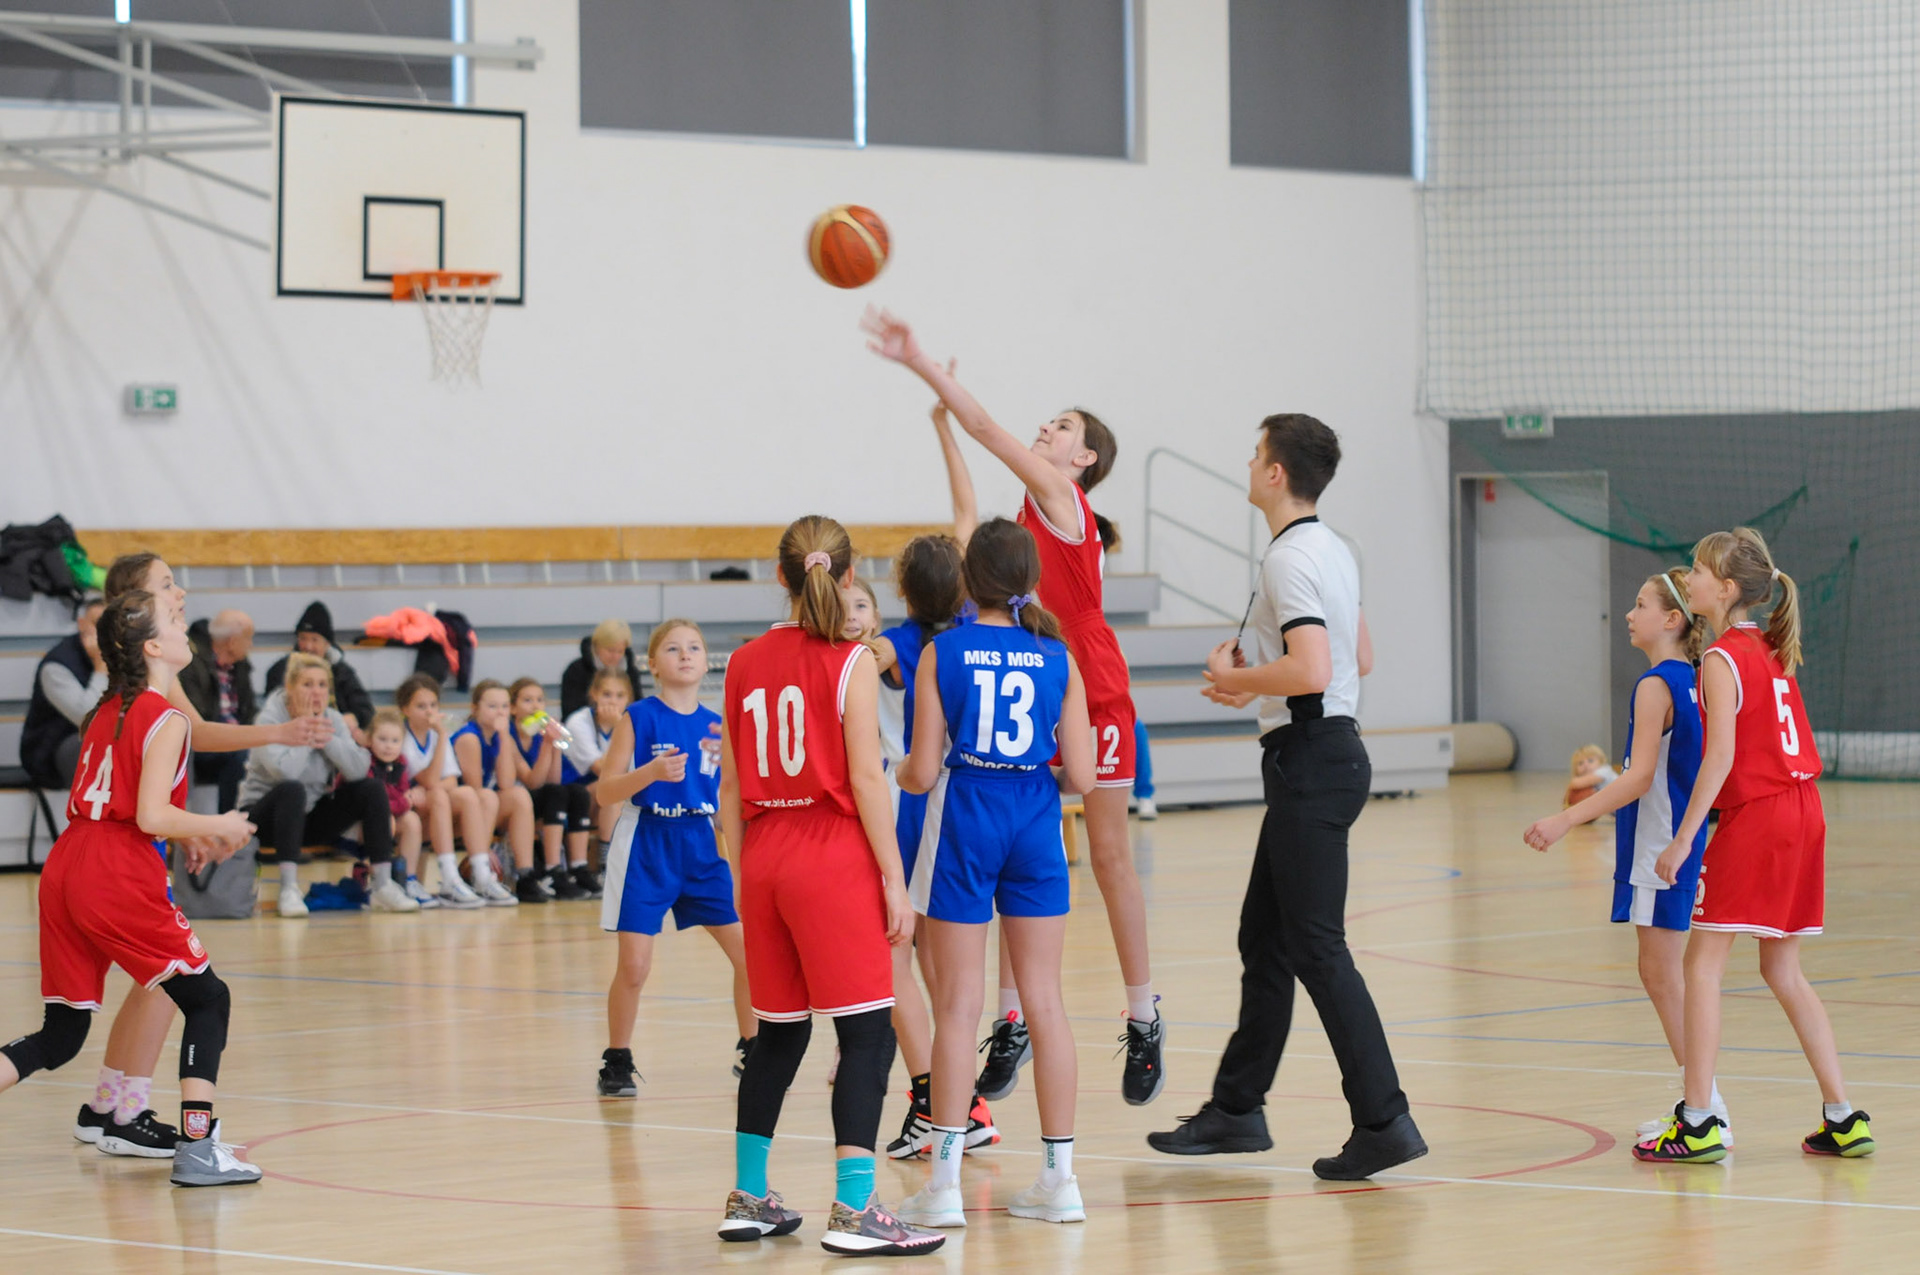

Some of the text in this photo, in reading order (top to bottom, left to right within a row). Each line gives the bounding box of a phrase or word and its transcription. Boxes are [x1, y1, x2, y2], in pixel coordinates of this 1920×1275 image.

[964, 650, 1045, 668] MKS MOS
[742, 685, 806, 778] 10
[974, 669, 1035, 757] 13
[1772, 677, 1800, 757] 5
[1096, 765, 1116, 775] AKO
